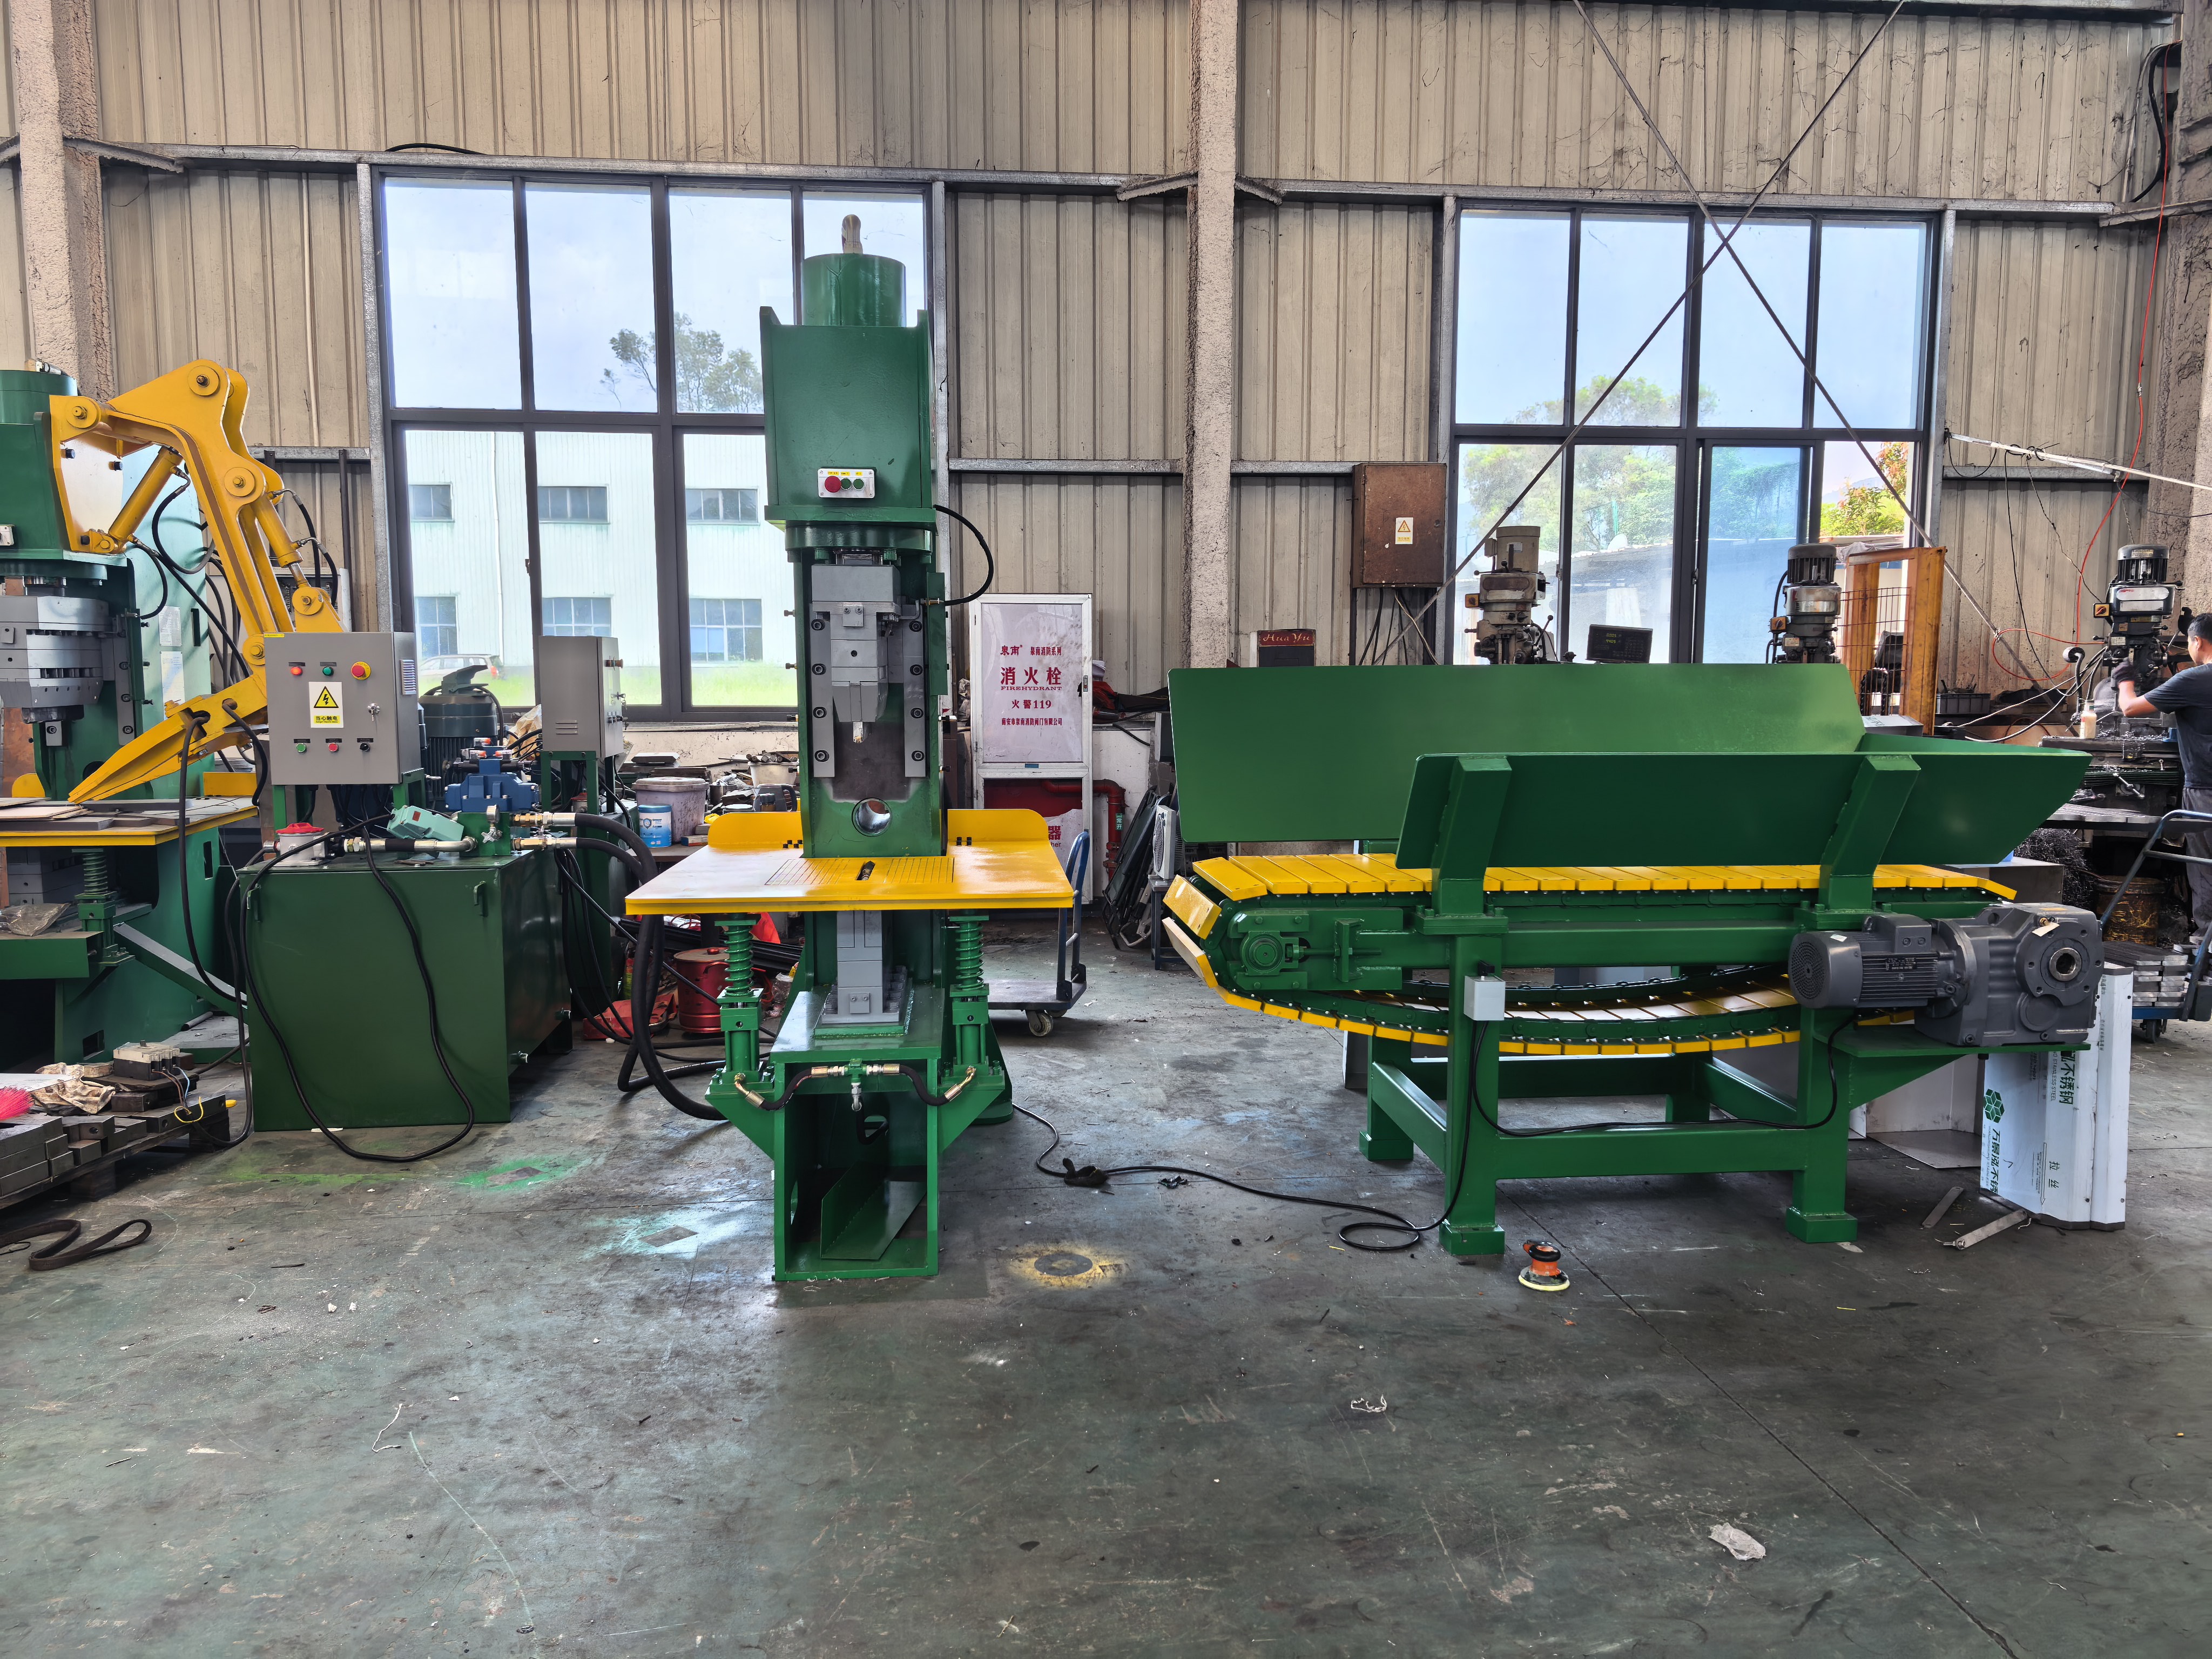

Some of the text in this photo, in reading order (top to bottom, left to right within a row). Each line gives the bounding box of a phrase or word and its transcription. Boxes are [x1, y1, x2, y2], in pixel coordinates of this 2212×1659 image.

[1292, 633, 1310, 643] Yu
[1000, 666, 1062, 685] 消火栓
